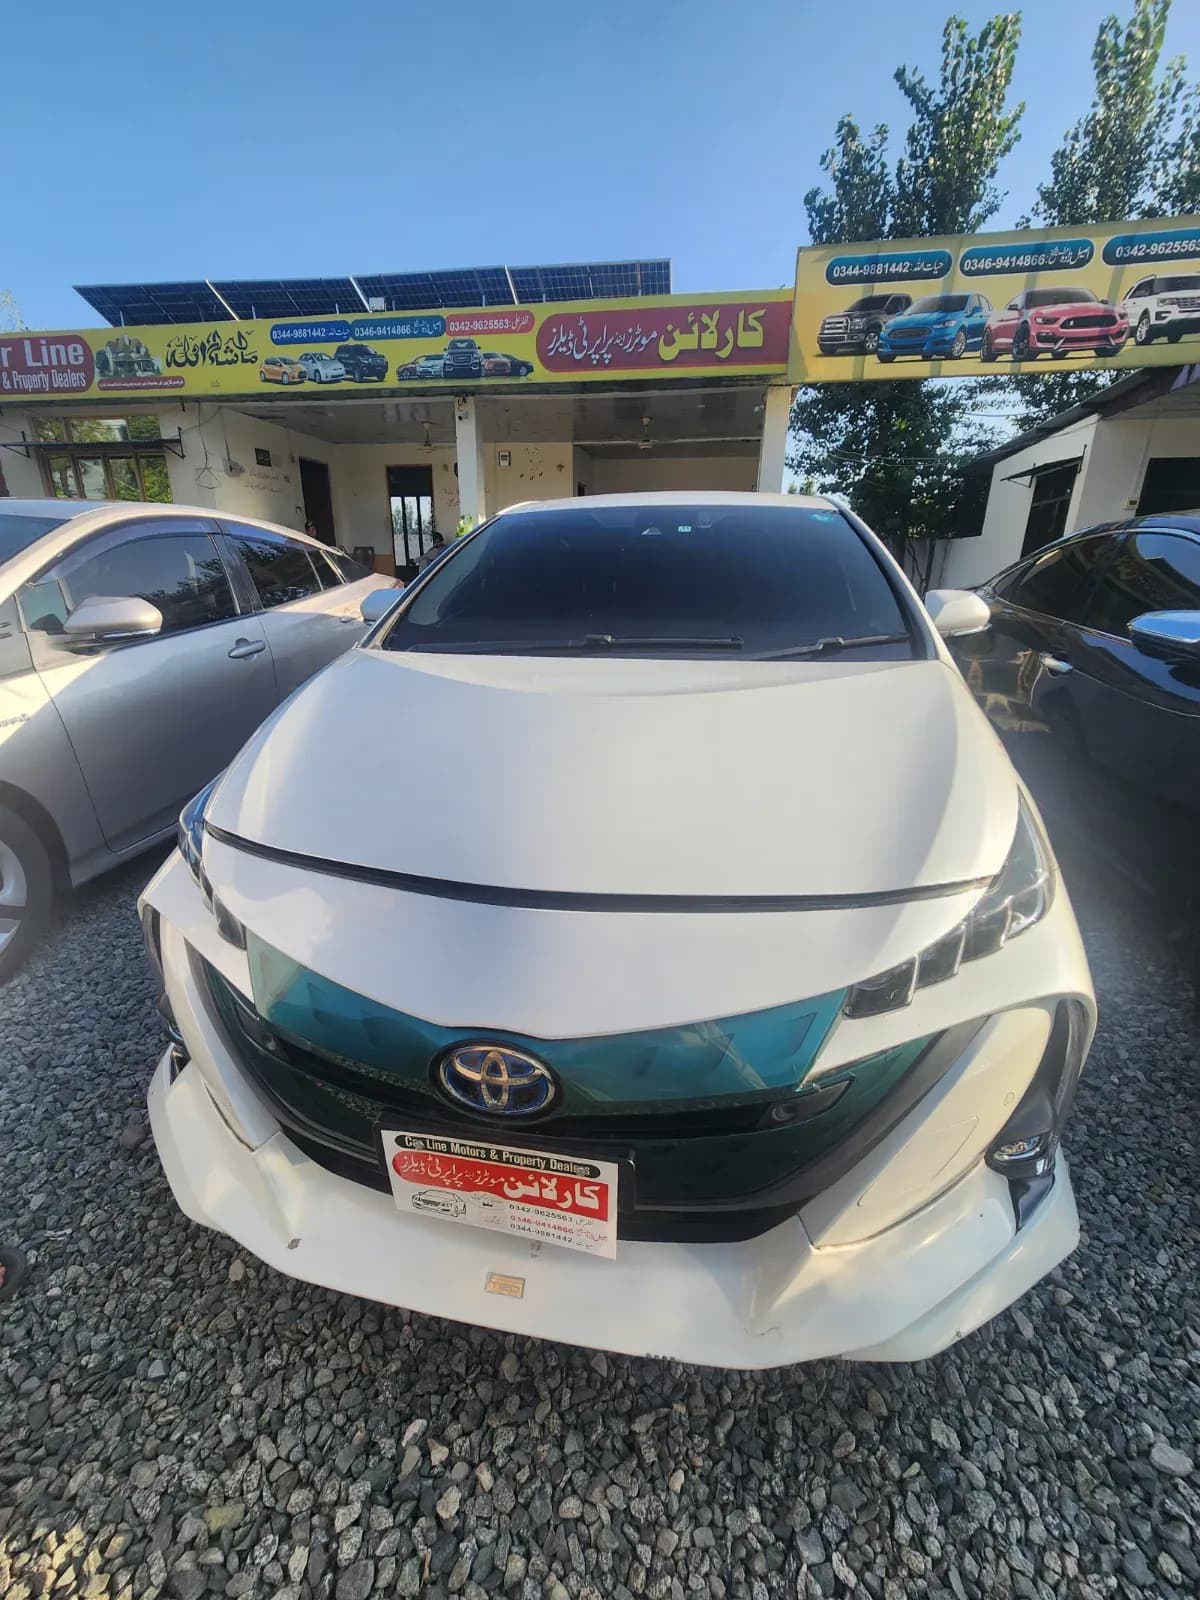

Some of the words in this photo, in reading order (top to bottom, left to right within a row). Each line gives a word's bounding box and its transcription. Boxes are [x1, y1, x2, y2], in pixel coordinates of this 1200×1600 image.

[833, 262, 910, 277] 0344-9881442
[964, 254, 1046, 270] 0346-9414866
[24, 338, 84, 367] Line
[2, 371, 11, 390] &
[12, 370, 49, 392] Property
[51, 368, 86, 388] Dealers
[404, 1136, 424, 1149] Ca
[426, 1138, 447, 1152] Line
[450, 1142, 486, 1159] Motors
[489, 1149, 499, 1160] &
[502, 1151, 546, 1170] Property
[549, 1159, 590, 1176] Deales
